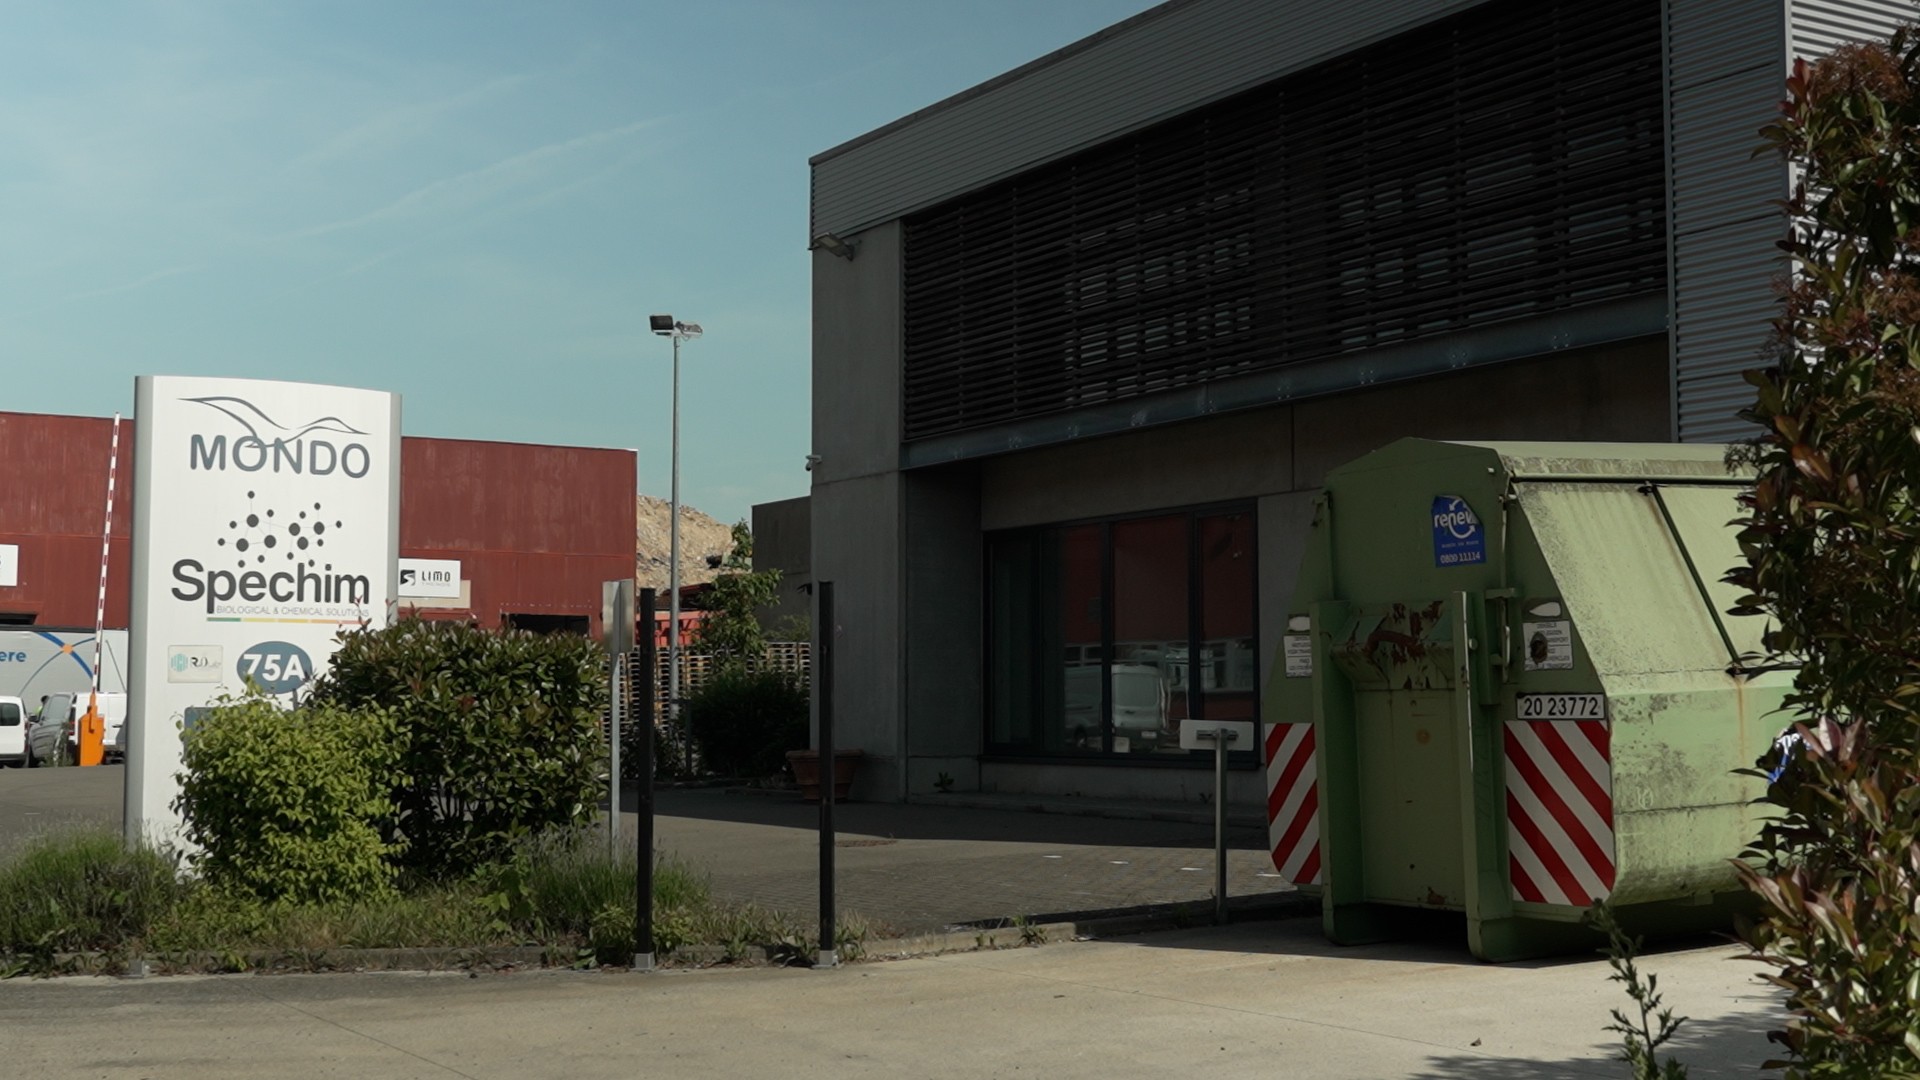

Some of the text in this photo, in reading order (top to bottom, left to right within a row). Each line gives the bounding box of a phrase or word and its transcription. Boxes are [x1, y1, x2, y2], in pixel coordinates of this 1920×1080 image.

[190, 433, 370, 479] MONDO
[171, 558, 370, 614] Spechim
[421, 570, 451, 583] LIMO
[216, 604, 370, 618] BIOLOGICAL & CHEMICAL SOLUTIONS
[243, 653, 305, 682] 75A
[1524, 697, 1599, 716] 20 23772
